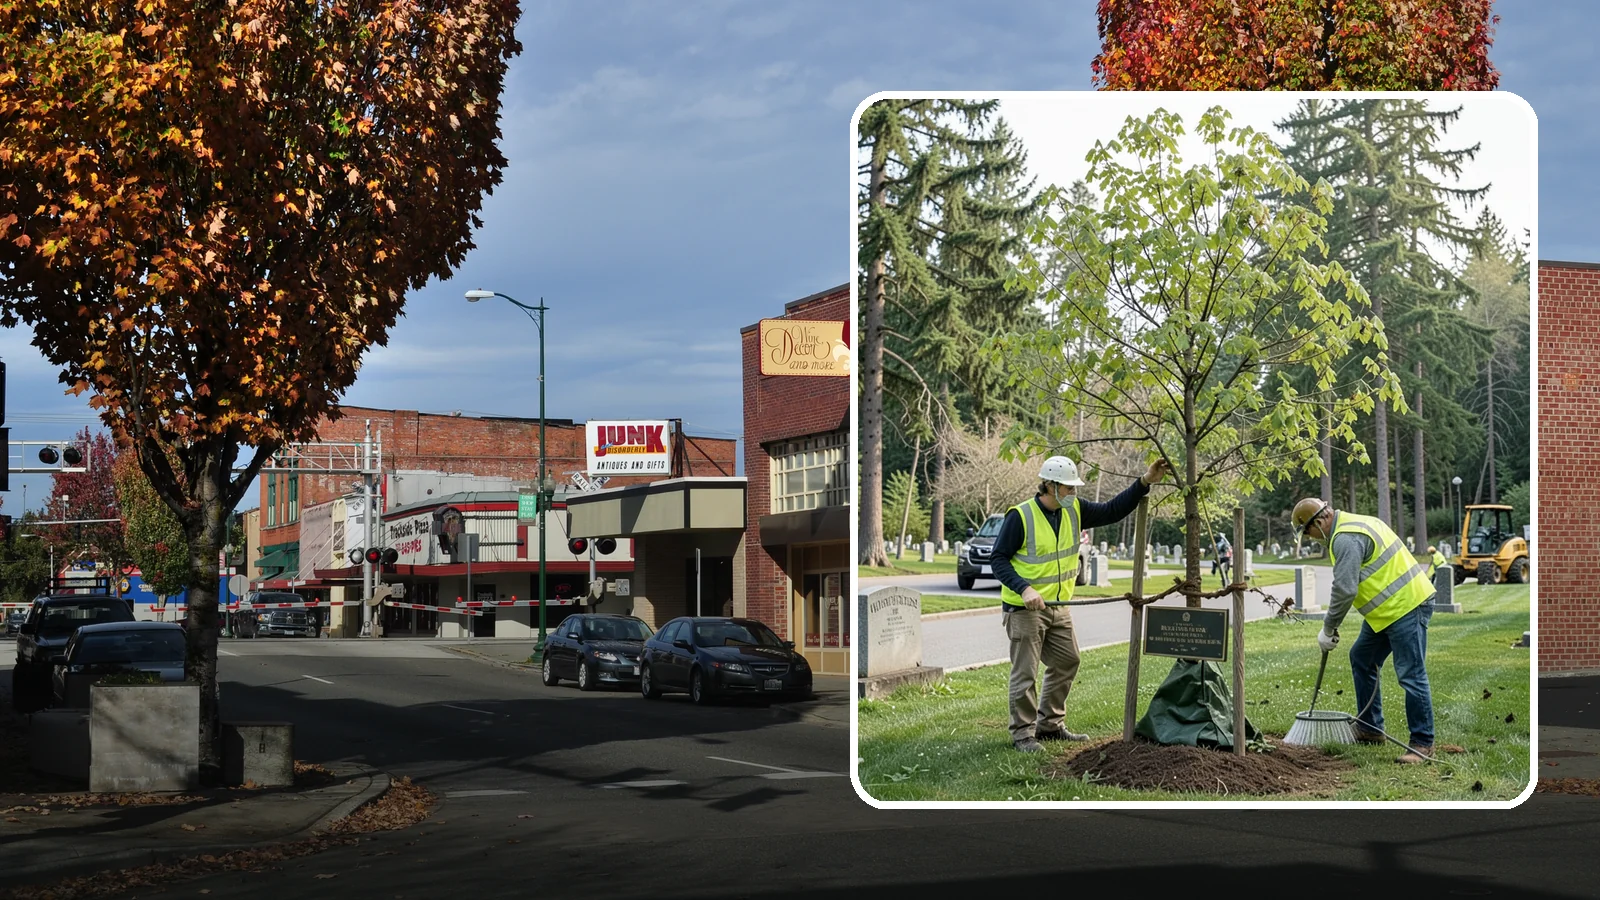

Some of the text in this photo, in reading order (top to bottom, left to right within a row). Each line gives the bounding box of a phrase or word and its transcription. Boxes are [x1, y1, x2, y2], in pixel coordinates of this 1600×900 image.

[595, 425, 665, 457] JUNK
[607, 446, 646, 454] DISORDERLY
[597, 461, 665, 470] ANTIQUES AND GIFTS
[415, 520, 429, 534] Pizza
